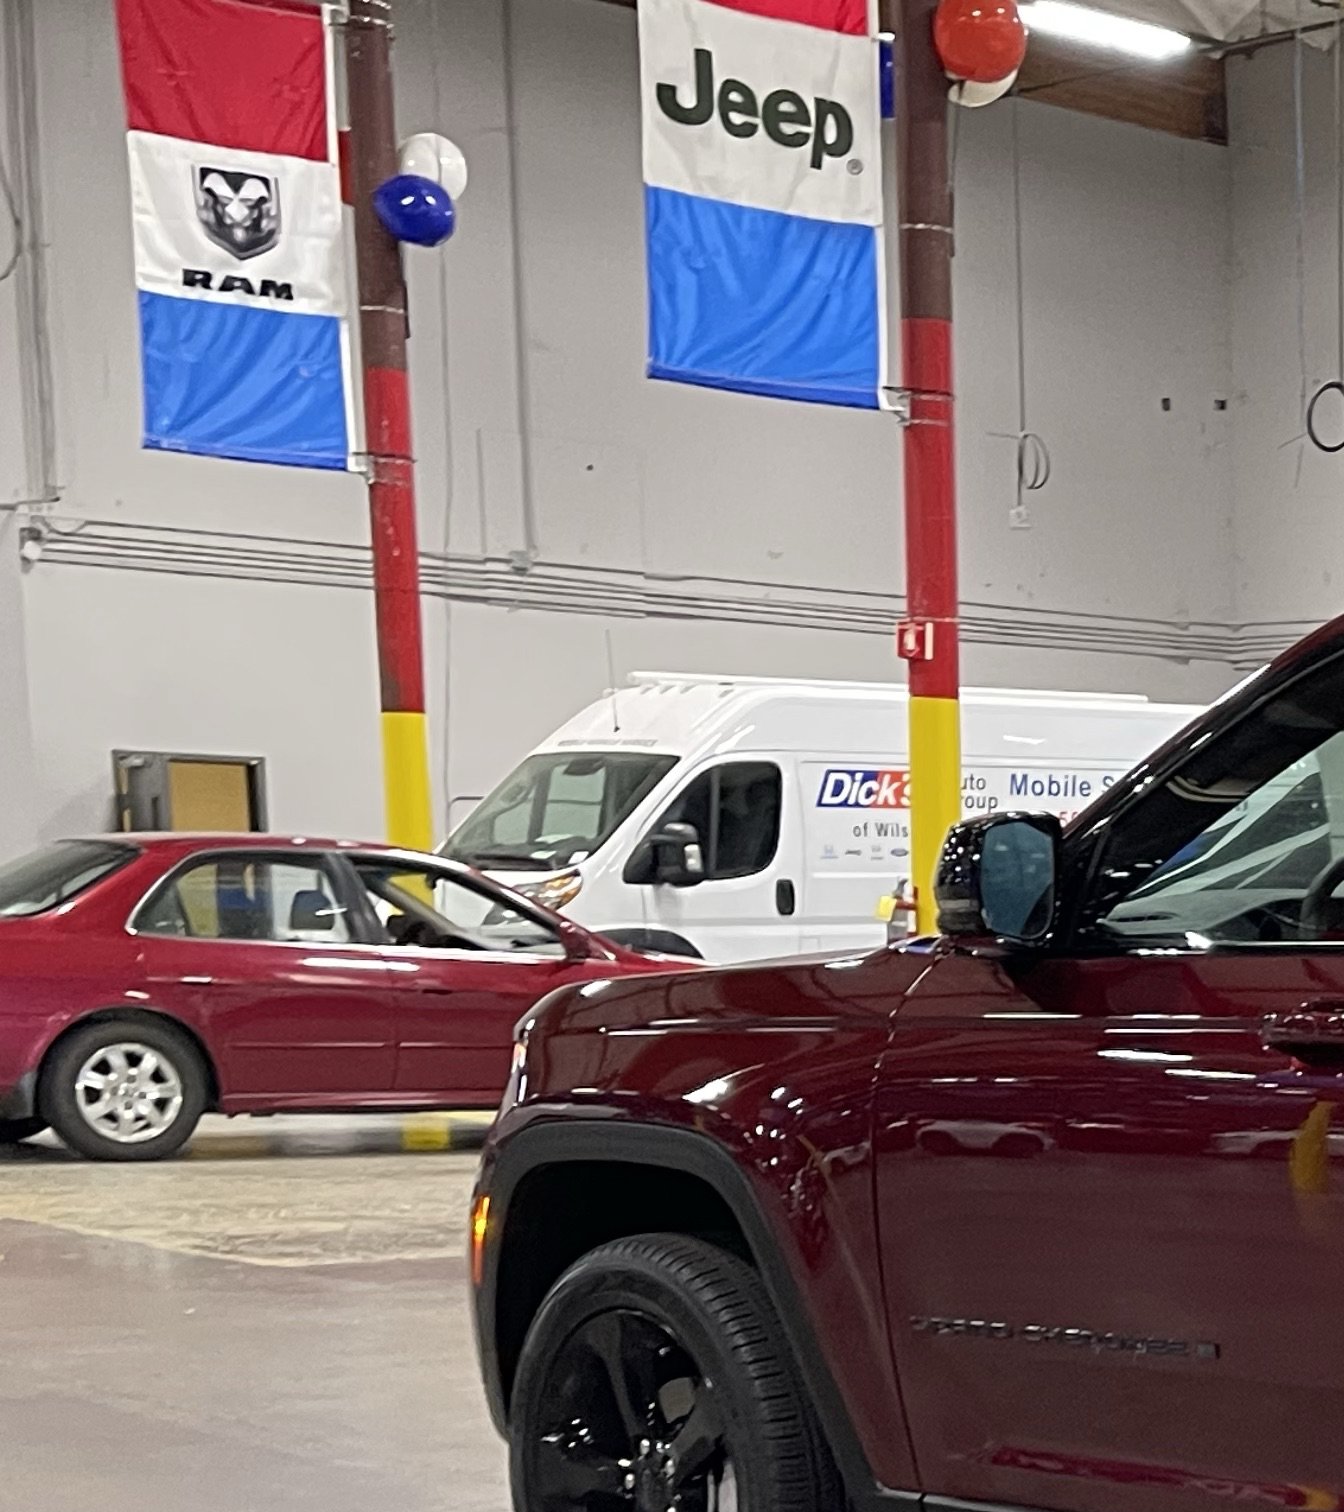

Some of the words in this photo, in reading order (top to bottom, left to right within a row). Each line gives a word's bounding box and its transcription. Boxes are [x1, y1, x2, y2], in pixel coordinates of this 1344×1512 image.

[656, 48, 854, 170] Jeep
[182, 268, 294, 301] RAM
[960, 773, 986, 790] uto
[1010, 773, 1092, 797] Mobile
[960, 795, 999, 814] oup
[853, 821, 868, 837] of
[875, 822, 908, 838] Wils
